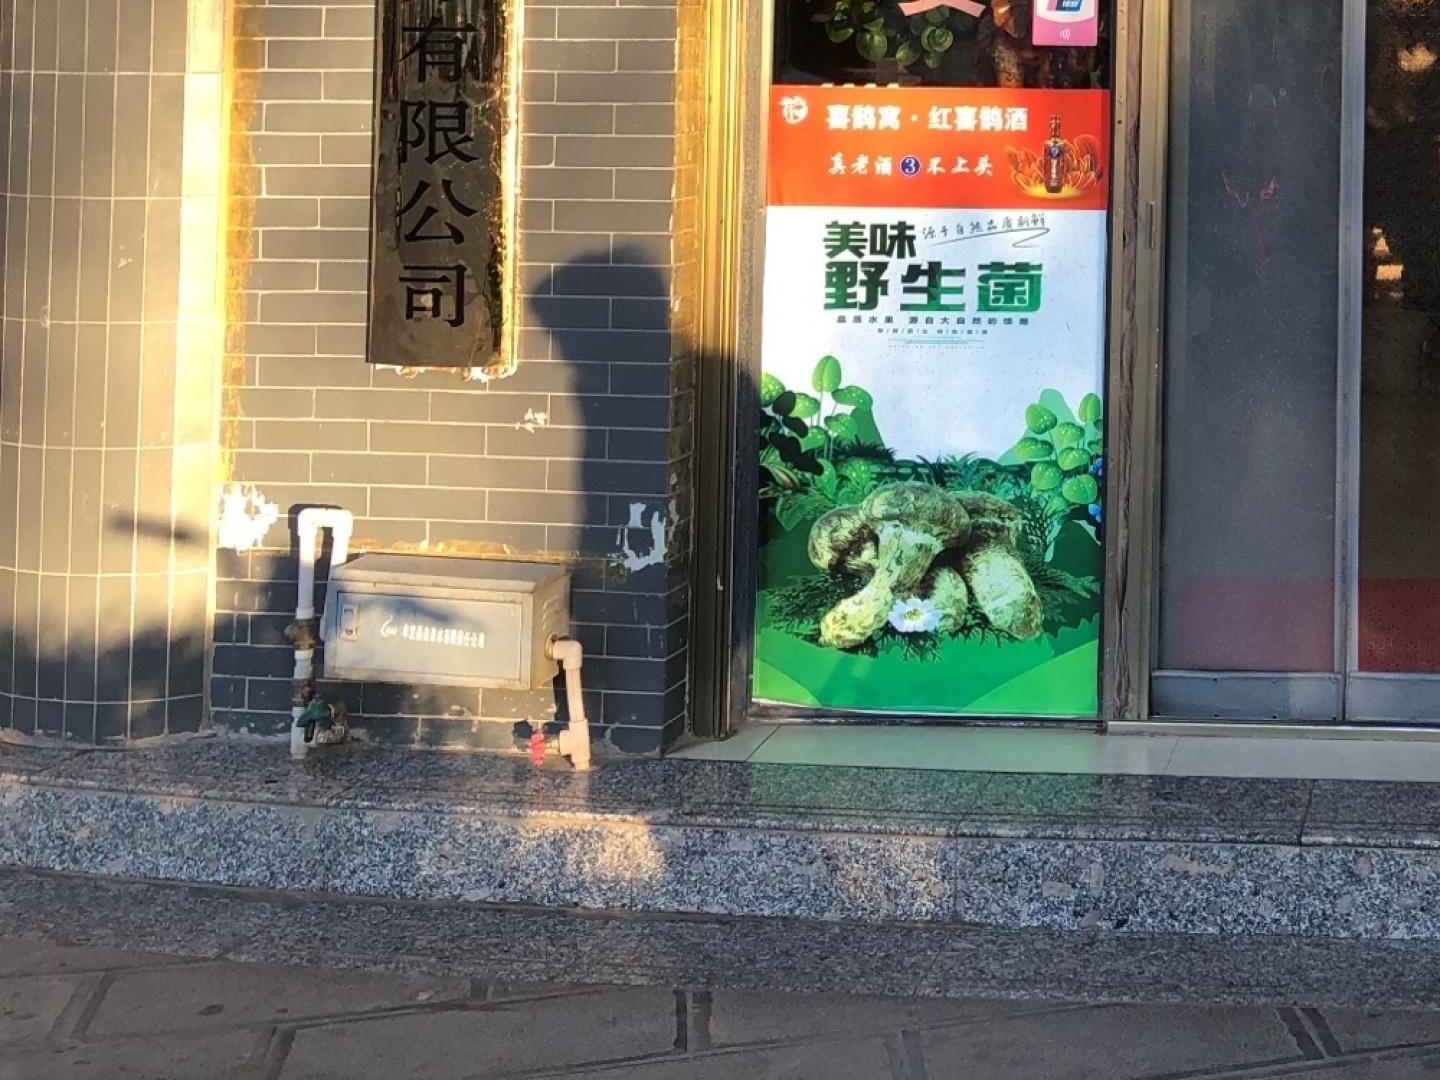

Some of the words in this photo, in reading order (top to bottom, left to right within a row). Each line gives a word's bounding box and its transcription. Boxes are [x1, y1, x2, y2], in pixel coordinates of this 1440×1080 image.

[822, 220, 917, 260] 美味
[823, 260, 1044, 313] 野生菌
